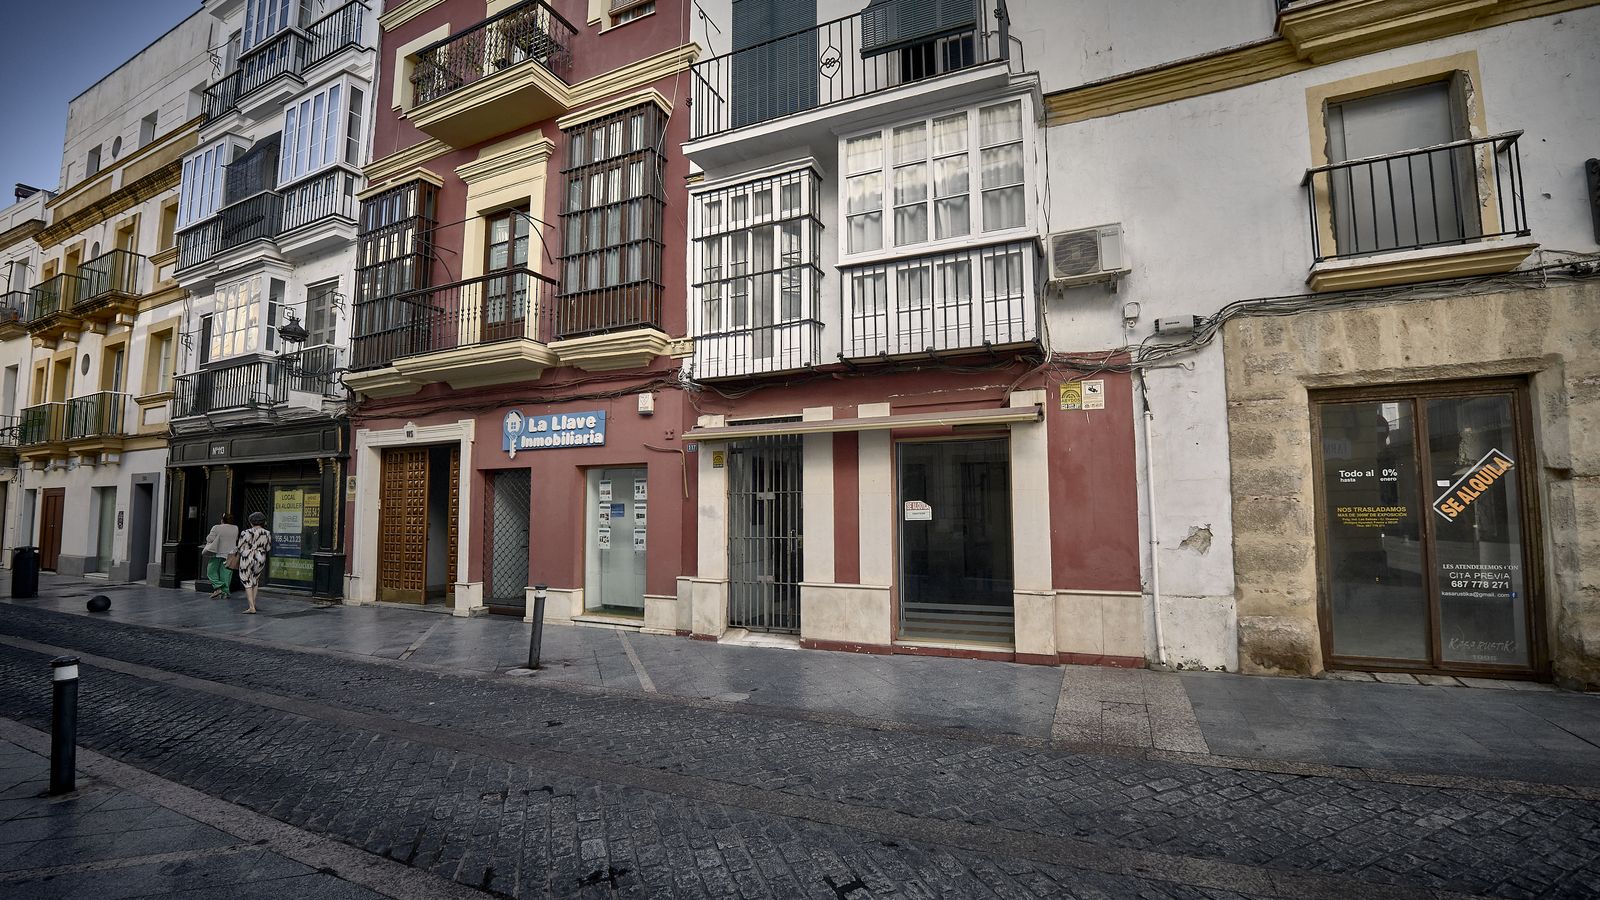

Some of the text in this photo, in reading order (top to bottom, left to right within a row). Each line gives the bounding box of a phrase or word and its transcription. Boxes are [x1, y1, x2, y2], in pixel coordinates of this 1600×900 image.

[528, 415, 597, 433] La Llave
[406, 430, 414, 438] 115
[520, 429, 604, 448] Inmobiliaria
[1365, 469, 1375, 477] al
[1382, 468, 1398, 477] 0%
[1440, 456, 1513, 518] SE ALQUILA
[1449, 572, 1511, 580] CITA PREVIA
[1451, 580, 1509, 589] 687 778 271
